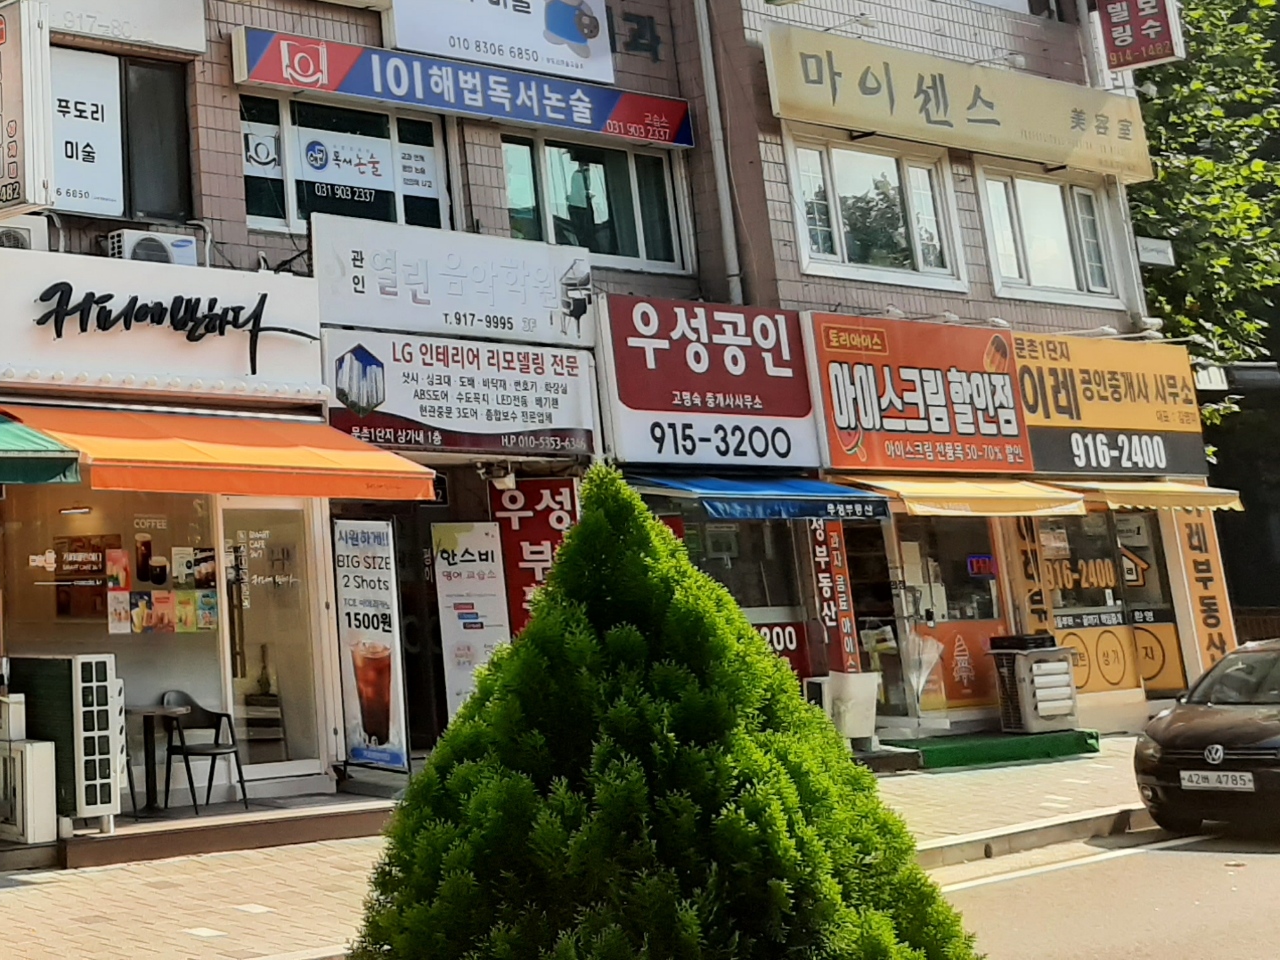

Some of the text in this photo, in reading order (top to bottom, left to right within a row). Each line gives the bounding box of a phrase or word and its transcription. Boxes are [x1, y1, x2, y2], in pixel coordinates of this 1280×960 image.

[448, 35, 470, 51] 010
[474, 39, 505, 57] 8306
[508, 44, 539, 63] 6850
[798, 49, 1001, 129] 마이센스
[56, 98, 105, 123] 푸도리
[606, 119, 670, 141] 031 903 2337
[64, 140, 97, 164] 미술
[65, 187, 91, 200] 6850
[350, 249, 366, 294] 관인
[626, 301, 794, 378] 우성공인
[391, 340, 579, 378] LG 인테리어 리모델링 전문
[413, 389, 449, 403] ABS도어
[1018, 363, 1194, 421] 이레 공인중개사 사무소
[396, 428, 425, 445] 상가내
[649, 421, 792, 460] 915-3200
[884, 440, 933, 460] 아이스크림
[1070, 432, 1167, 469] 916-2400
[495, 488, 573, 531] 우성
[826, 503, 873, 517] 우성부동산
[133, 518, 168, 530] COFFEE
[337, 554, 391, 571] BIG SIZE
[1044, 558, 1117, 590] 916-2400
[342, 574, 390, 591] 2 Shots
[441, 569, 497, 581] 영어 교습소
[344, 611, 392, 634] 1500원
[1215, 774, 1247, 786] 4785
